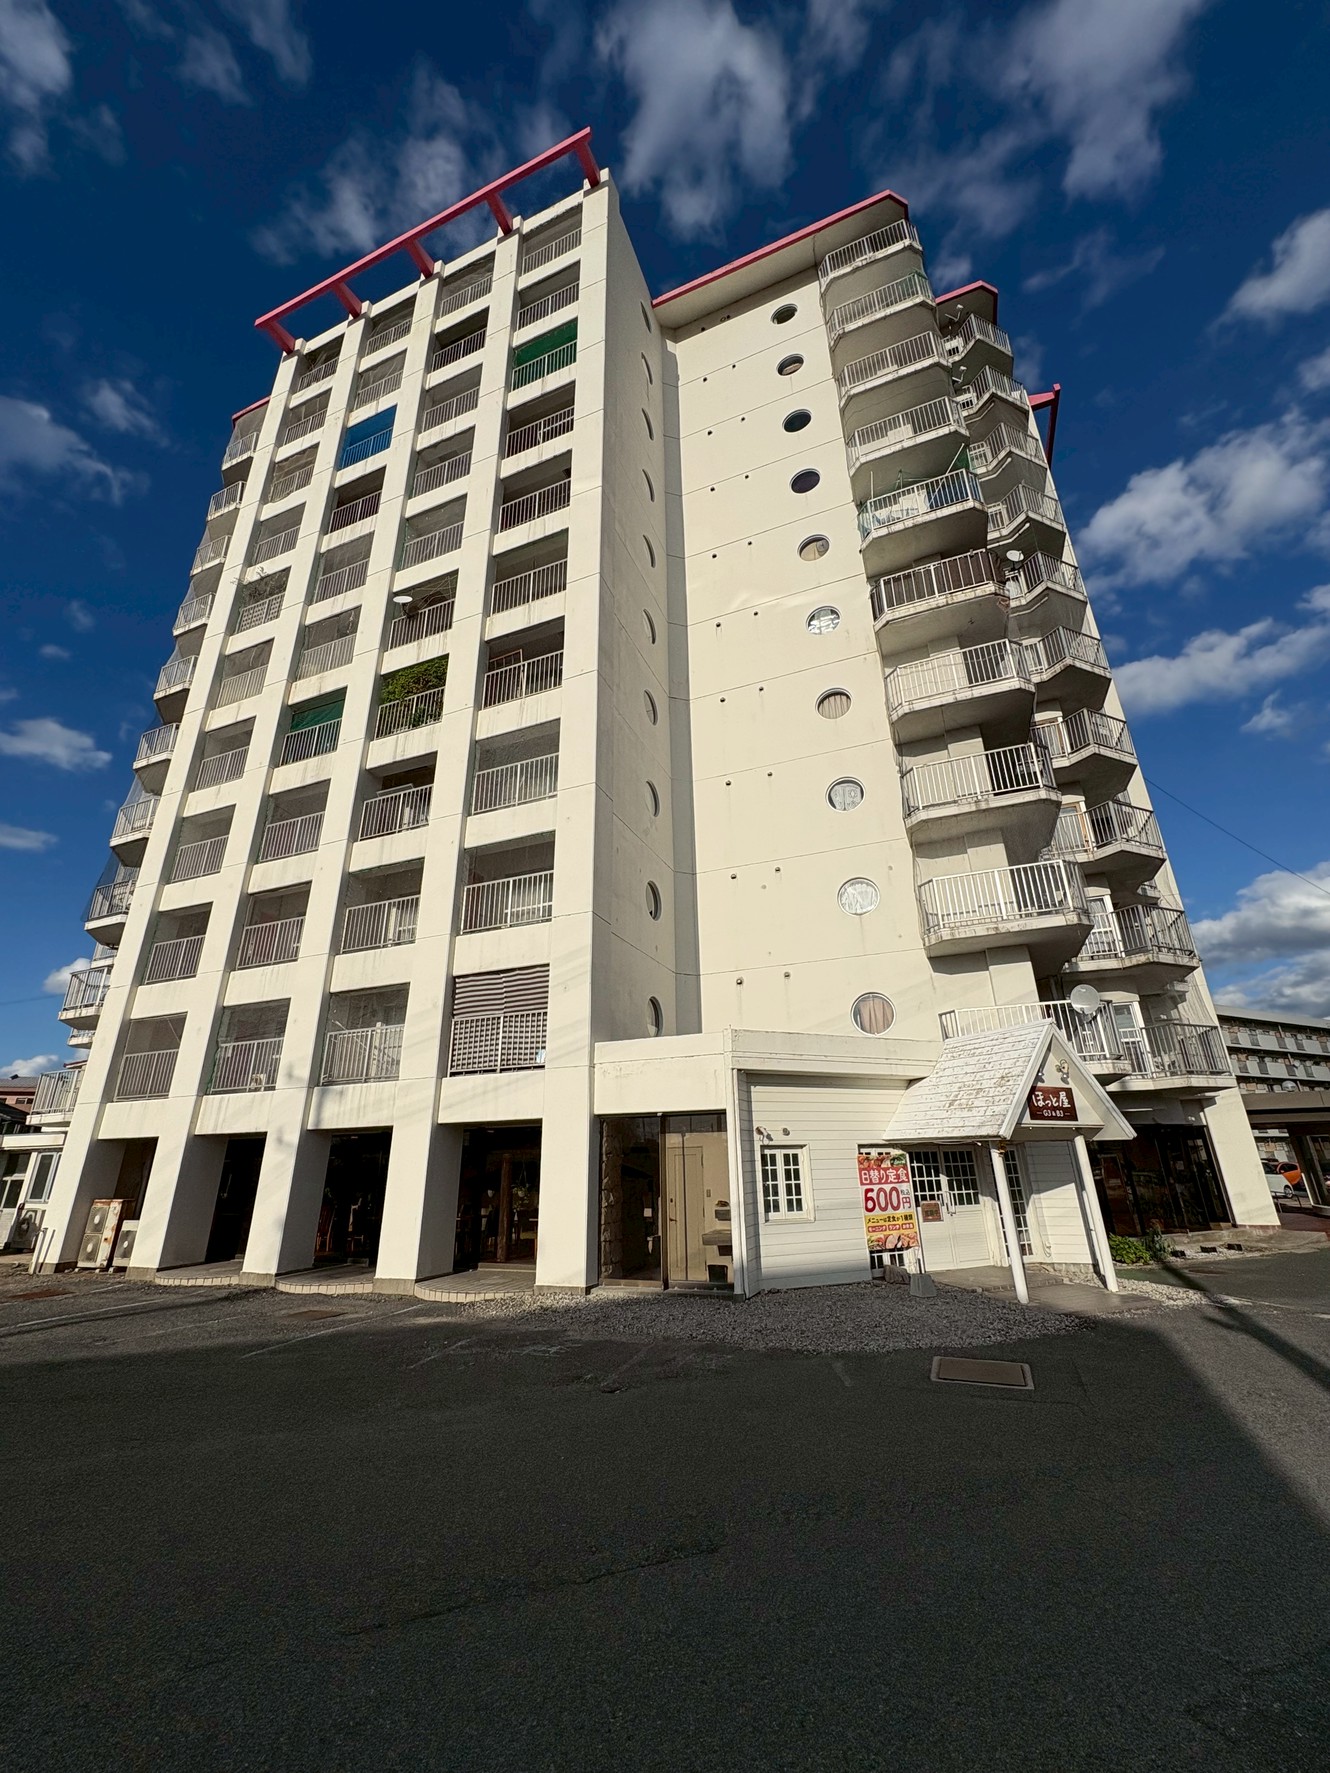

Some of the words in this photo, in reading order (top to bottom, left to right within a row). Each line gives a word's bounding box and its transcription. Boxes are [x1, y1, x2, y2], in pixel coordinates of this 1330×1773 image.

[1032, 1091, 1071, 1108] ほっと屋
[861, 1167, 908, 1184] 日替り定食
